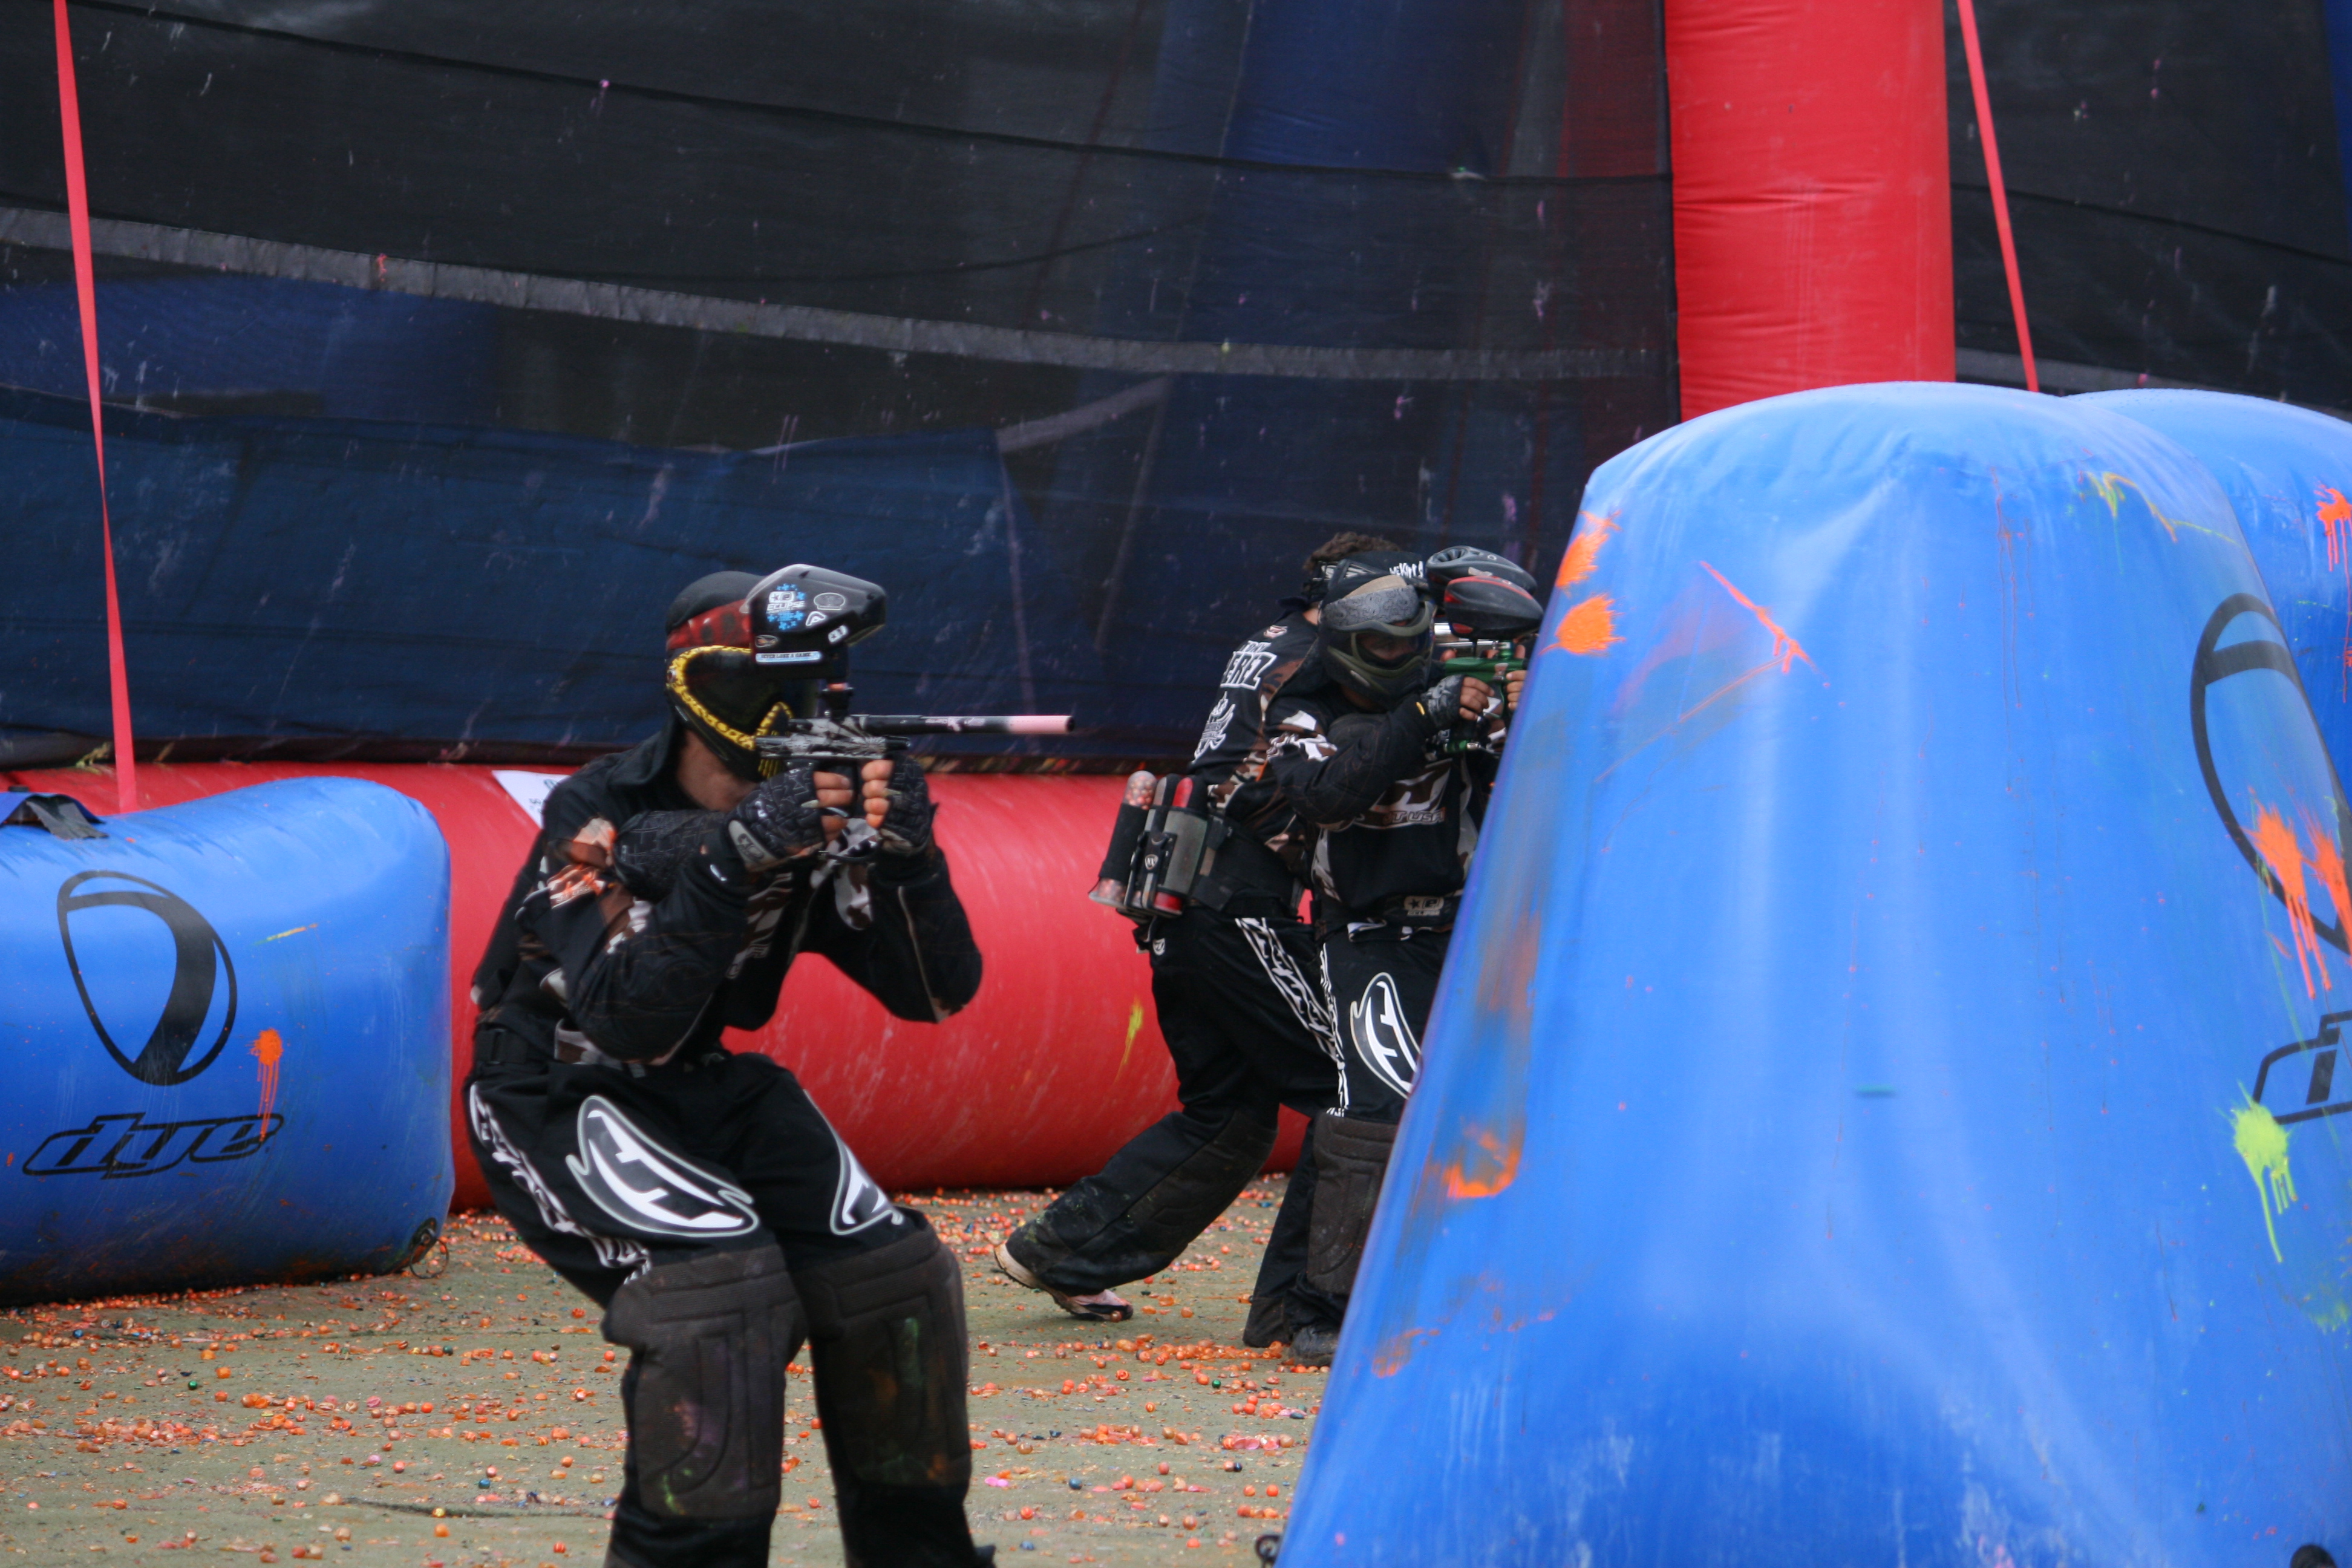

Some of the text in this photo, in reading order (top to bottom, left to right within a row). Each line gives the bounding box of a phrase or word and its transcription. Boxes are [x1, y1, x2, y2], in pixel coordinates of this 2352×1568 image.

[766, 601, 805, 611] ECLIPSE
[1408, 807, 1446, 824] USA
[22, 1112, 284, 1180] dye
